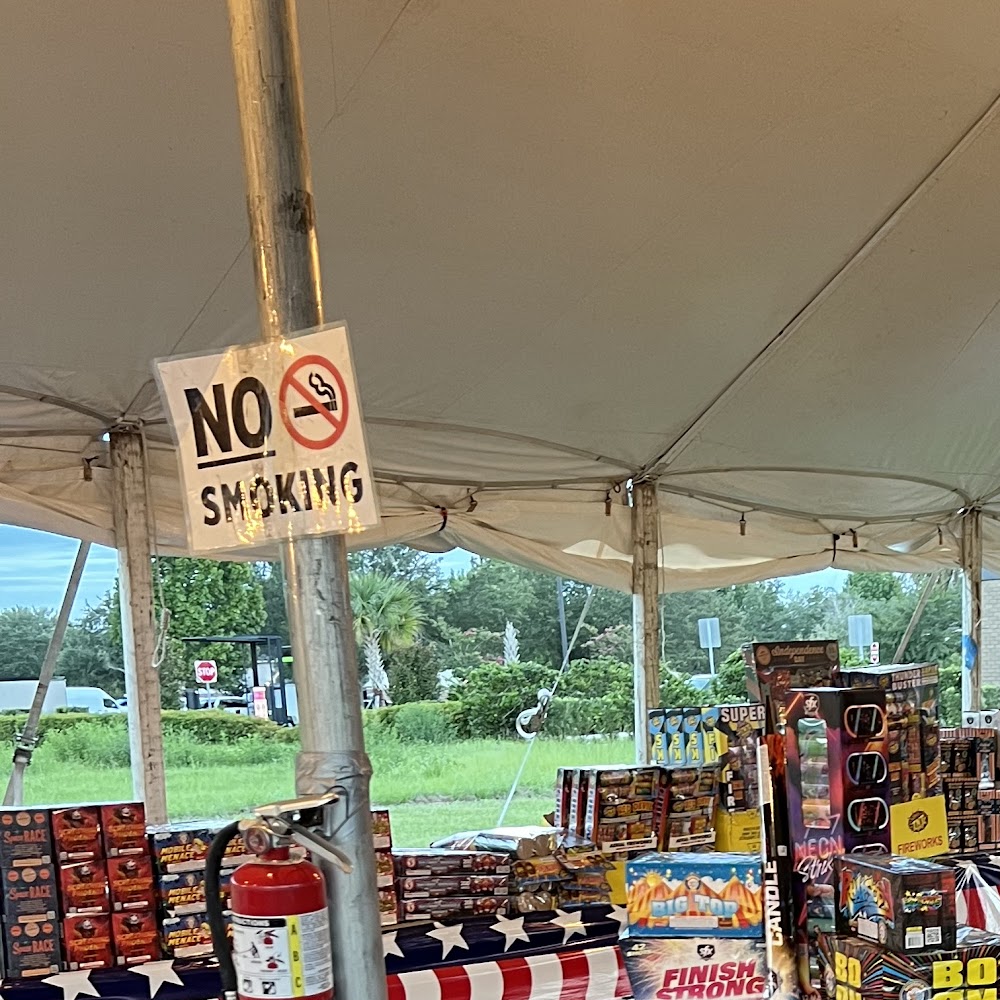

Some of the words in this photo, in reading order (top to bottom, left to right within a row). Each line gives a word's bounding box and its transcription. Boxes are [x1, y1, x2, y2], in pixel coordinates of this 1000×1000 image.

[184, 376, 273, 458] NO
[201, 461, 364, 526] SMOKING
[197, 666, 216, 677] STOP
[891, 668, 921, 683] THUNDER
[891, 679, 922, 691] BUSTER
[721, 706, 766, 722] SUPER
[23, 829, 47, 843] RACE
[161, 844, 193, 855] MOBILE
[795, 835, 846, 861] NEON
[897, 836, 943, 854] FIREWORKS
[161, 851, 195, 862] MENACE
[29, 885, 51, 899] RACE
[168, 886, 200, 897] MOBILE
[168, 893, 201, 904] MENACE
[651, 895, 689, 917] BIG
[694, 894, 739, 917] TOP
[764, 860, 784, 947] CANDLE
[168, 928, 201, 938] MOBILE
[291, 924, 297, 936] A
[32, 939, 54, 953] RACE
[168, 936, 202, 946] MENACE
[292, 951, 299, 962] B
[663, 961, 757, 989] FINISH
[932, 957, 998, 990] BO
[295, 977, 302, 988] C
